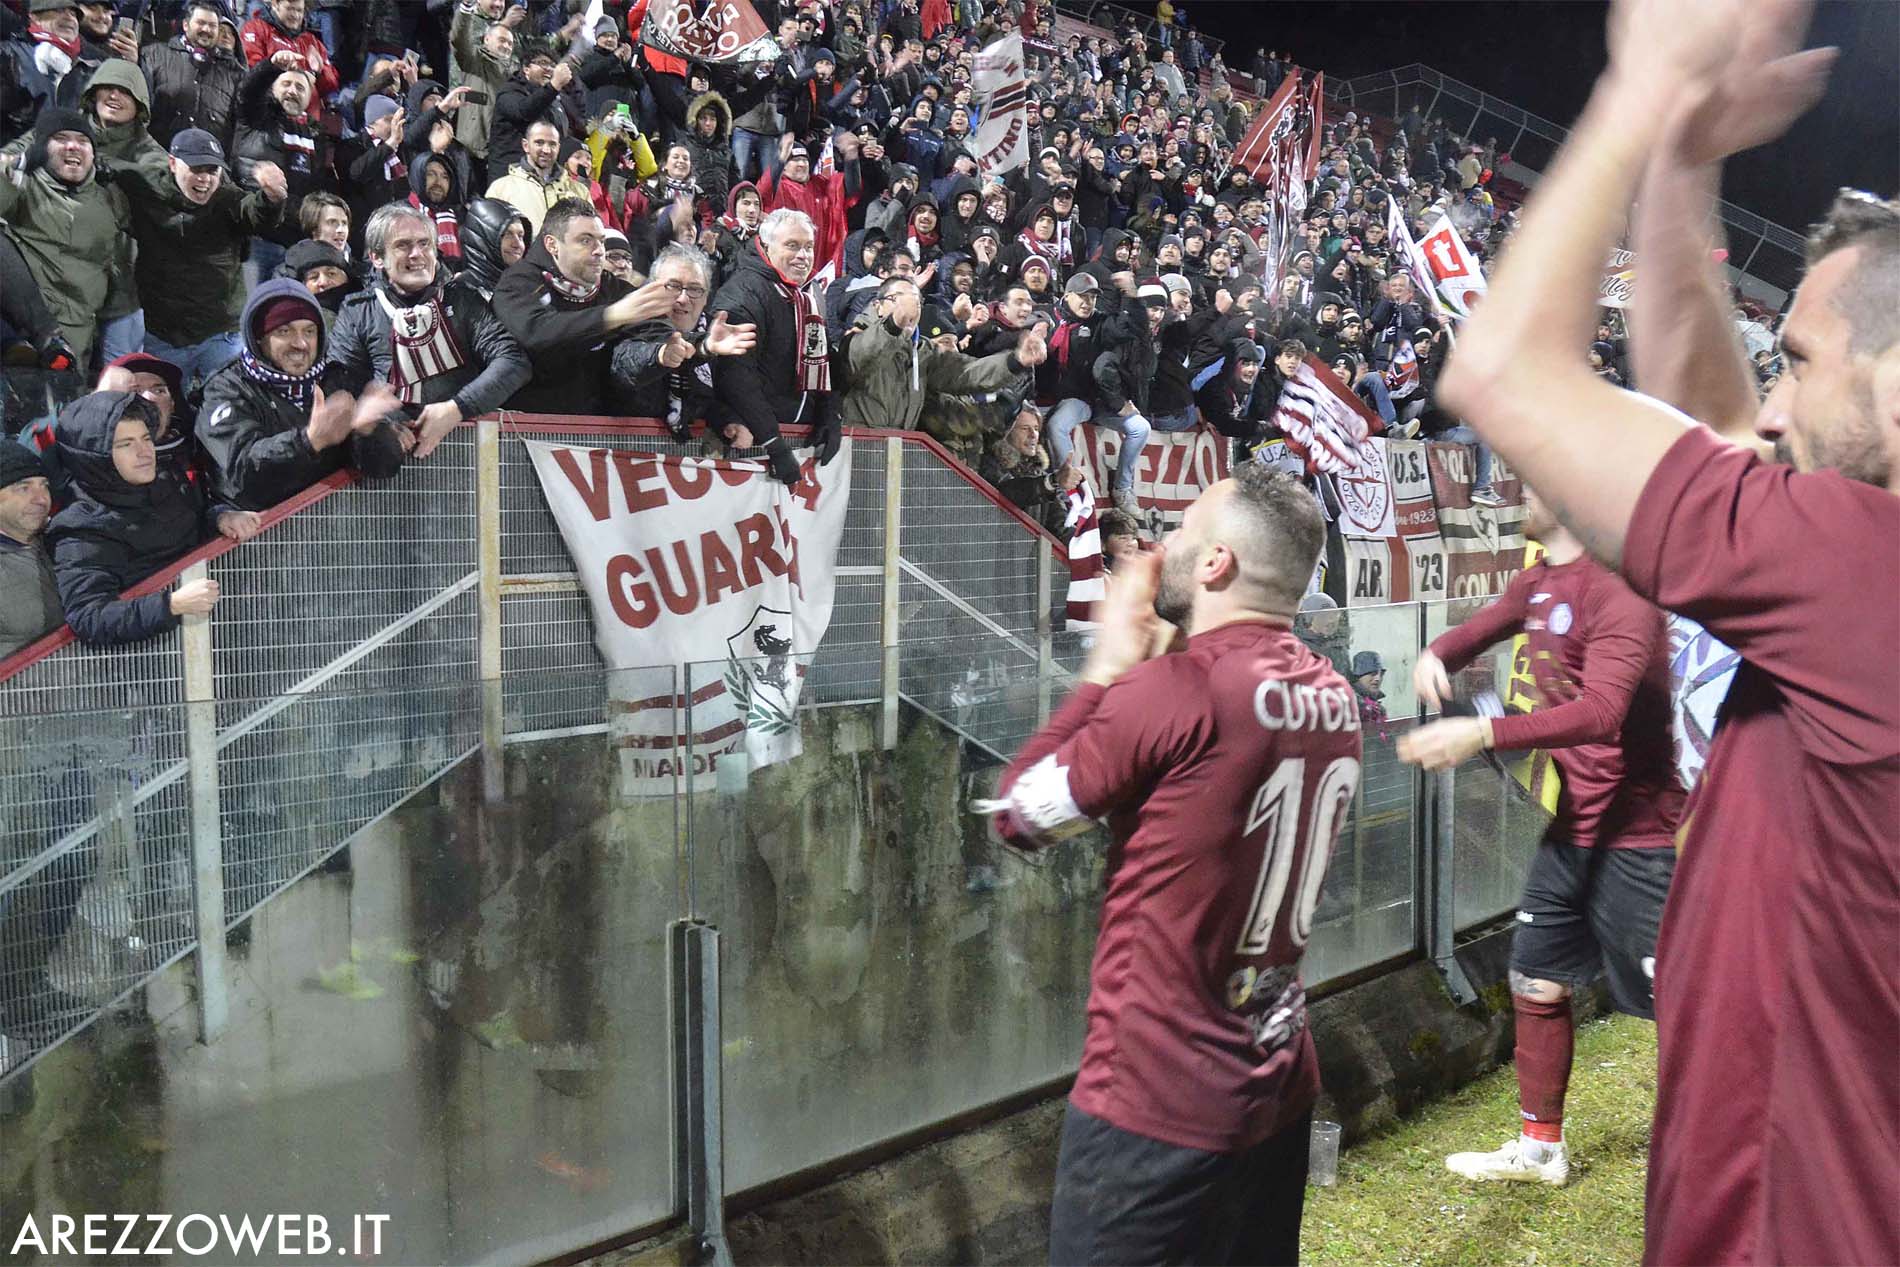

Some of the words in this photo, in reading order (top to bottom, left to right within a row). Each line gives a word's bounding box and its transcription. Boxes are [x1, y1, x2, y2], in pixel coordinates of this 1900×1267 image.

[1393, 451, 1426, 484] U.S.
[1354, 558, 1383, 598] AR
[1454, 572, 1494, 608] CON
[1254, 679, 1360, 732] CUTOL
[1235, 756, 1361, 955] 10
